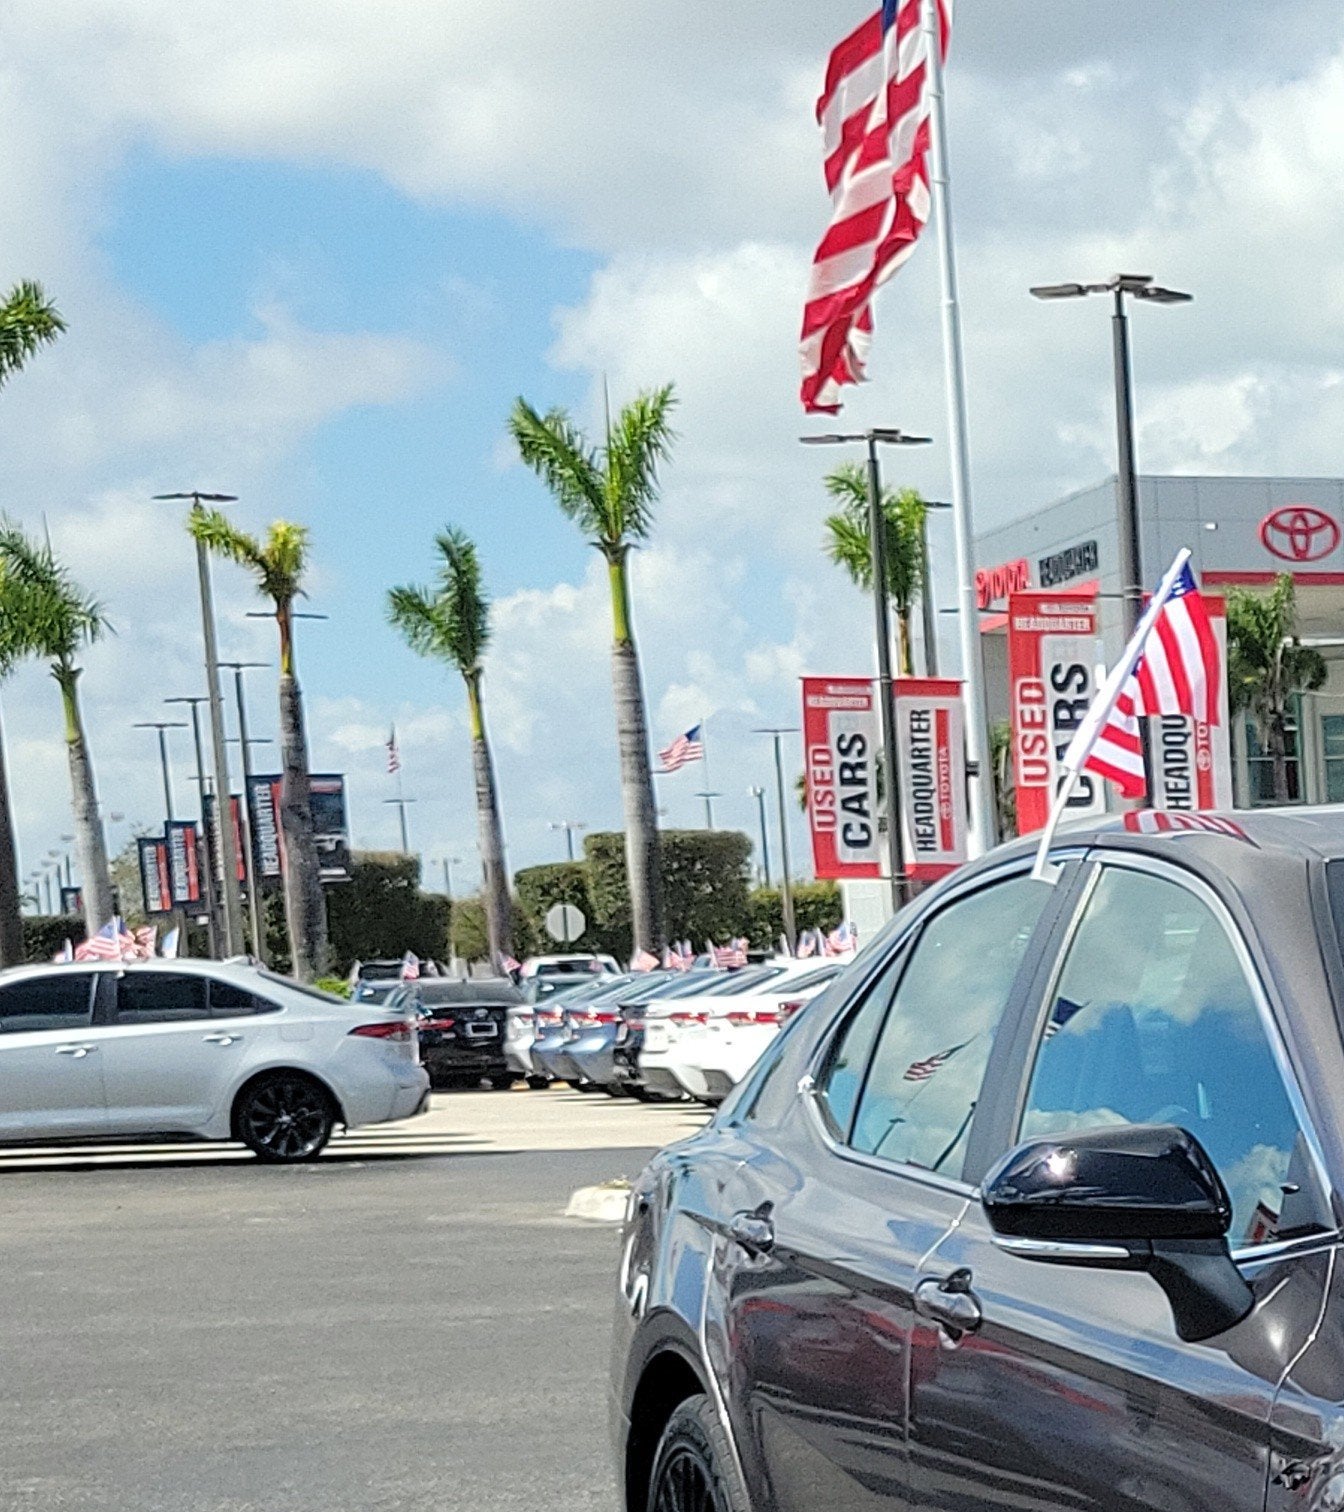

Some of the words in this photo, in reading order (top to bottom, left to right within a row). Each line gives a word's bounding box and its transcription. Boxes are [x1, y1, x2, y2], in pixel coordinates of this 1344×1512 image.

[909, 709, 937, 852] HEADQUARTER
[1018, 679, 1050, 784] USED
[1051, 663, 1094, 807] CRS
[1162, 714, 1192, 811] HEADQU
[812, 746, 837, 830] USED
[836, 733, 873, 849] CARS
